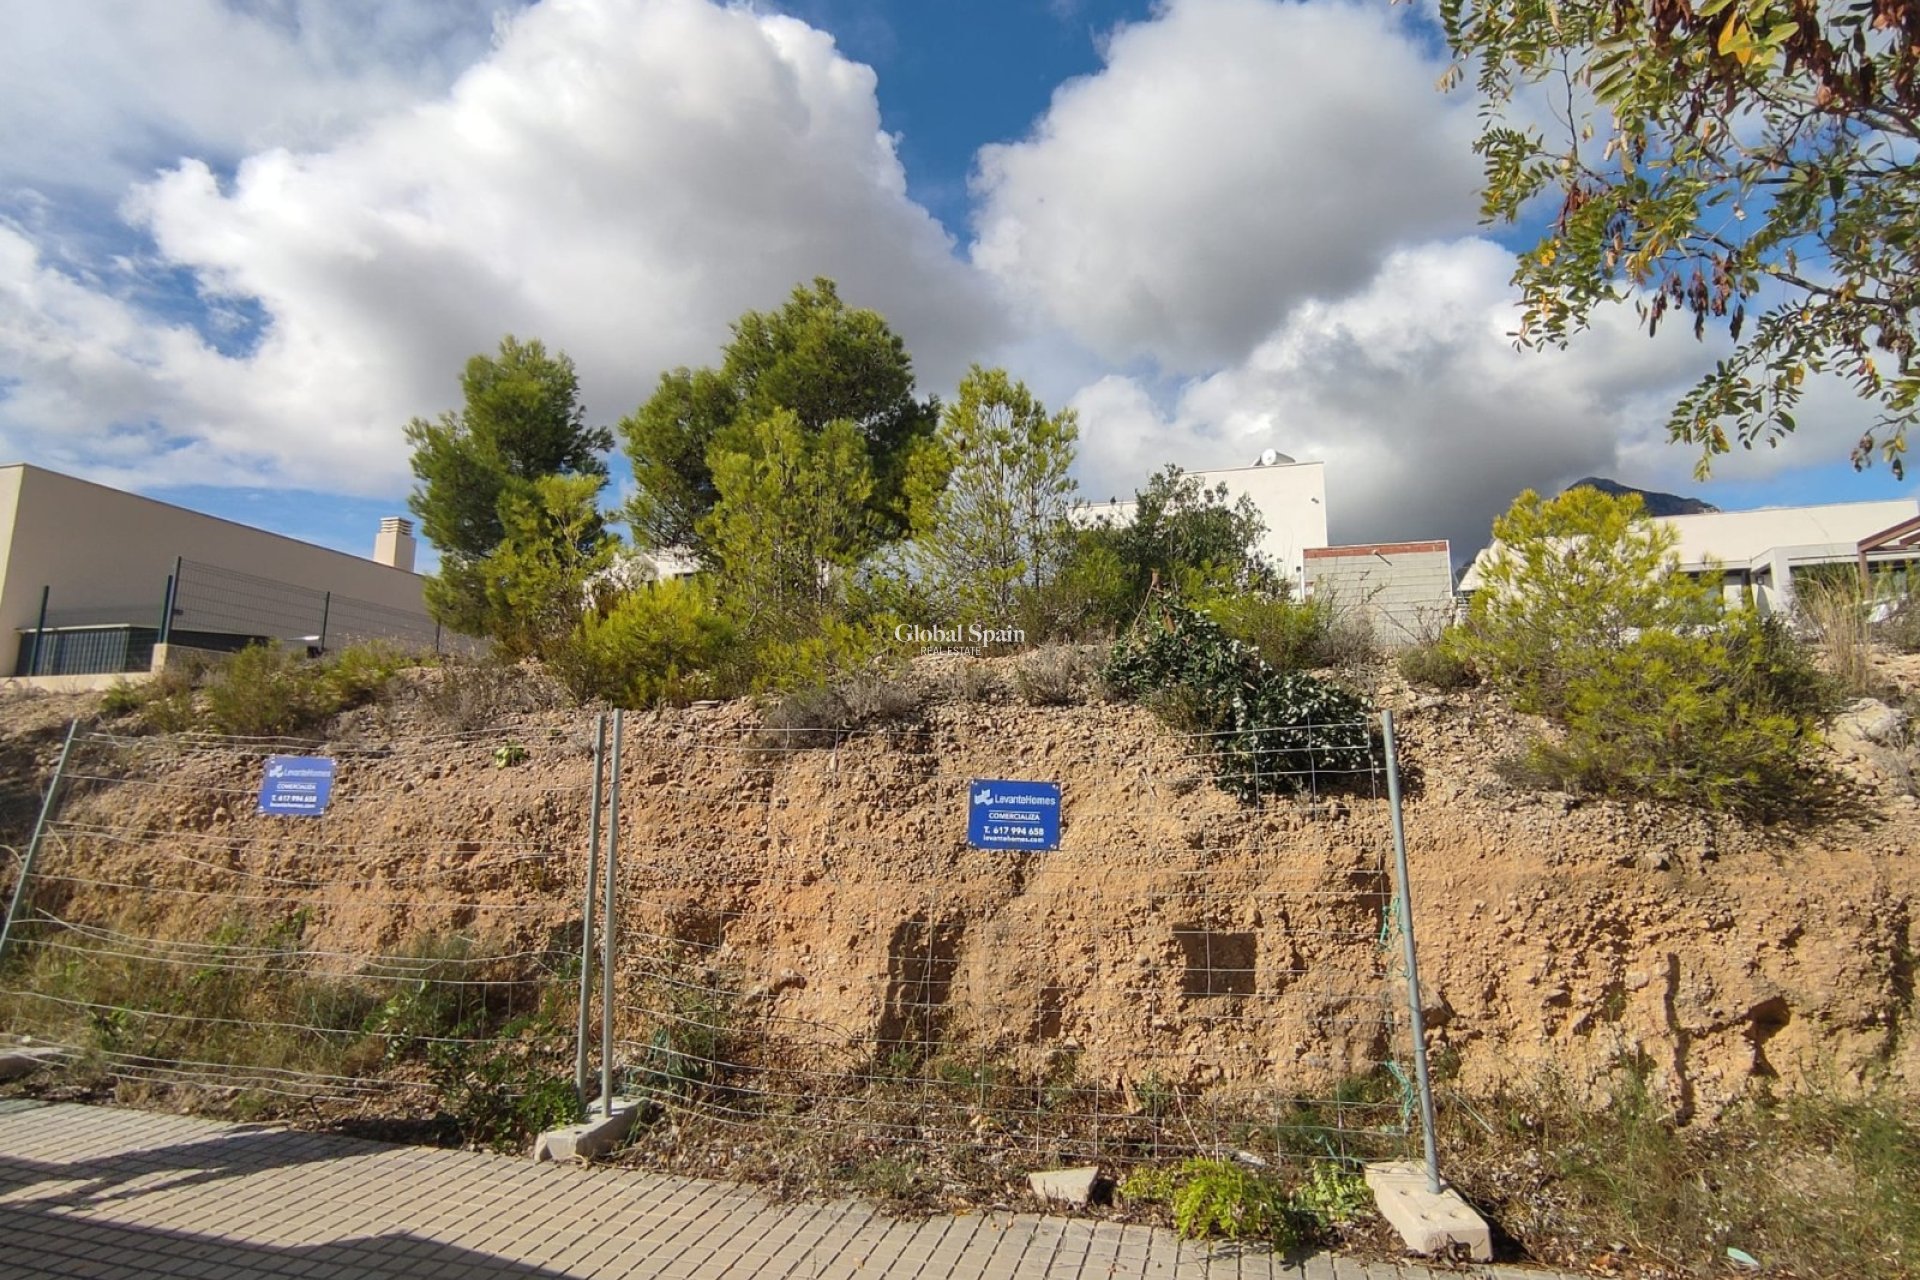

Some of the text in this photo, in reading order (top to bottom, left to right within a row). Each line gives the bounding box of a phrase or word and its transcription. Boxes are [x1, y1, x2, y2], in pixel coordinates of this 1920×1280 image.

[995, 794, 1056, 806] LevanteHomes
[988, 812, 1040, 821] COMERCIALIZA
[983, 825, 1044, 836] T. 617 994 658
[983, 834, 1044, 843] levantehomes.com
